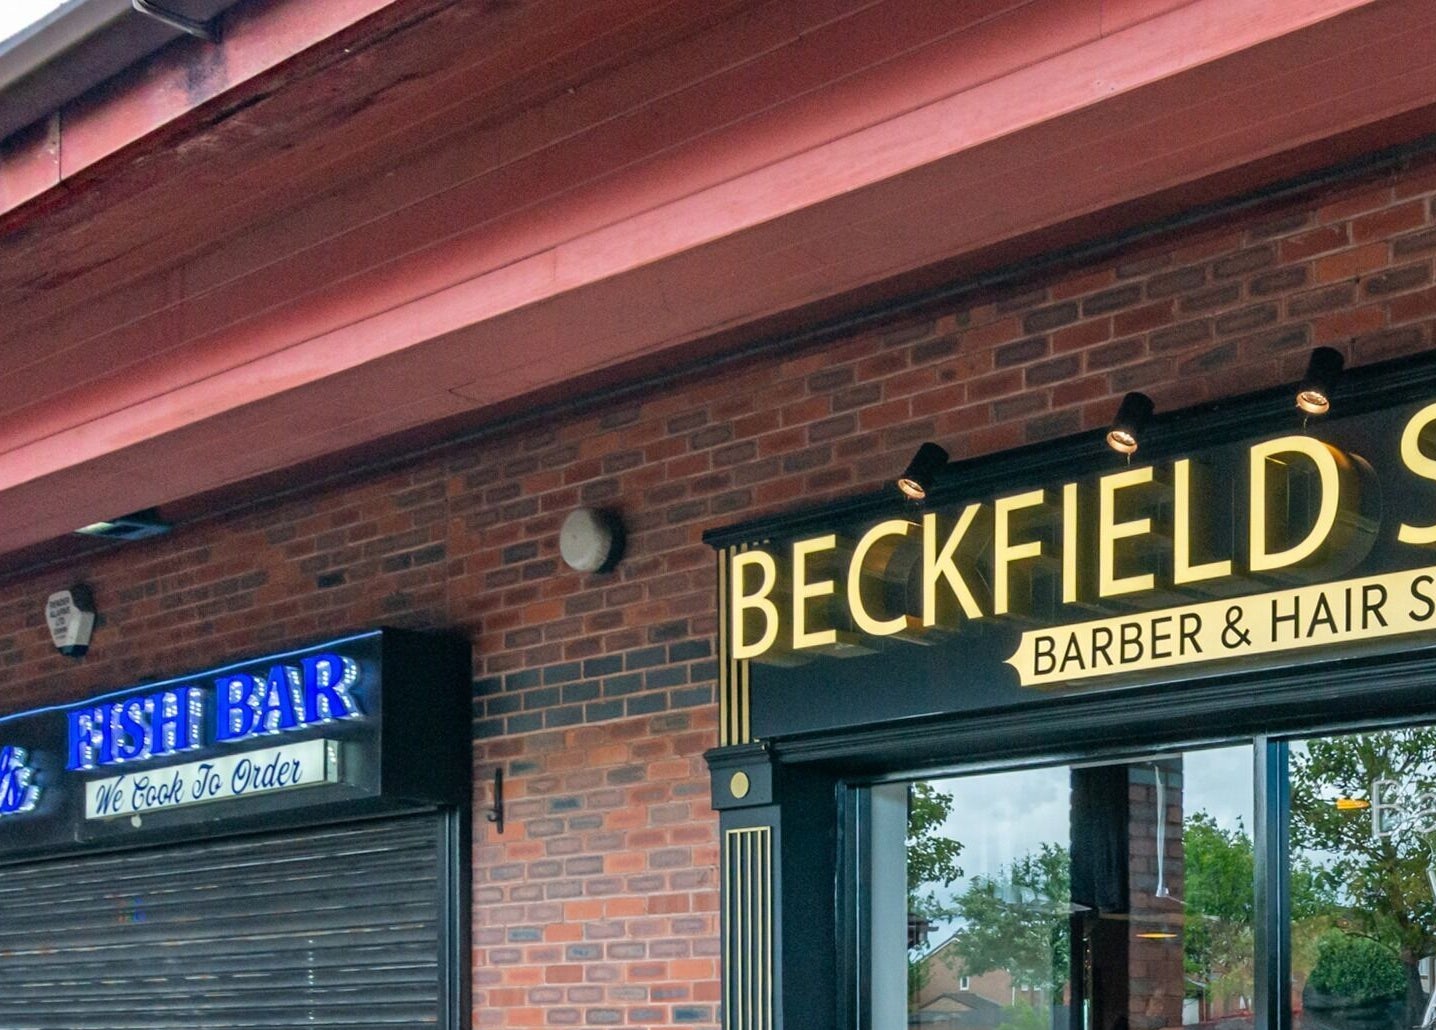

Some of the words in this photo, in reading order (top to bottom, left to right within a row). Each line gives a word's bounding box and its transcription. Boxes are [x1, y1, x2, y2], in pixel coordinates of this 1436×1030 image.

[731, 434, 1341, 662] BECKFIELD
[1032, 611, 1202, 677] BARBER
[1221, 606, 1251, 648] &
[1270, 584, 1389, 644] HAIR
[66, 686, 196, 771] FISH
[215, 652, 353, 742] BAR
[96, 775, 125, 815] We
[131, 770, 184, 811] Cook
[192, 763, 222, 801] To
[231, 751, 303, 794] Order
